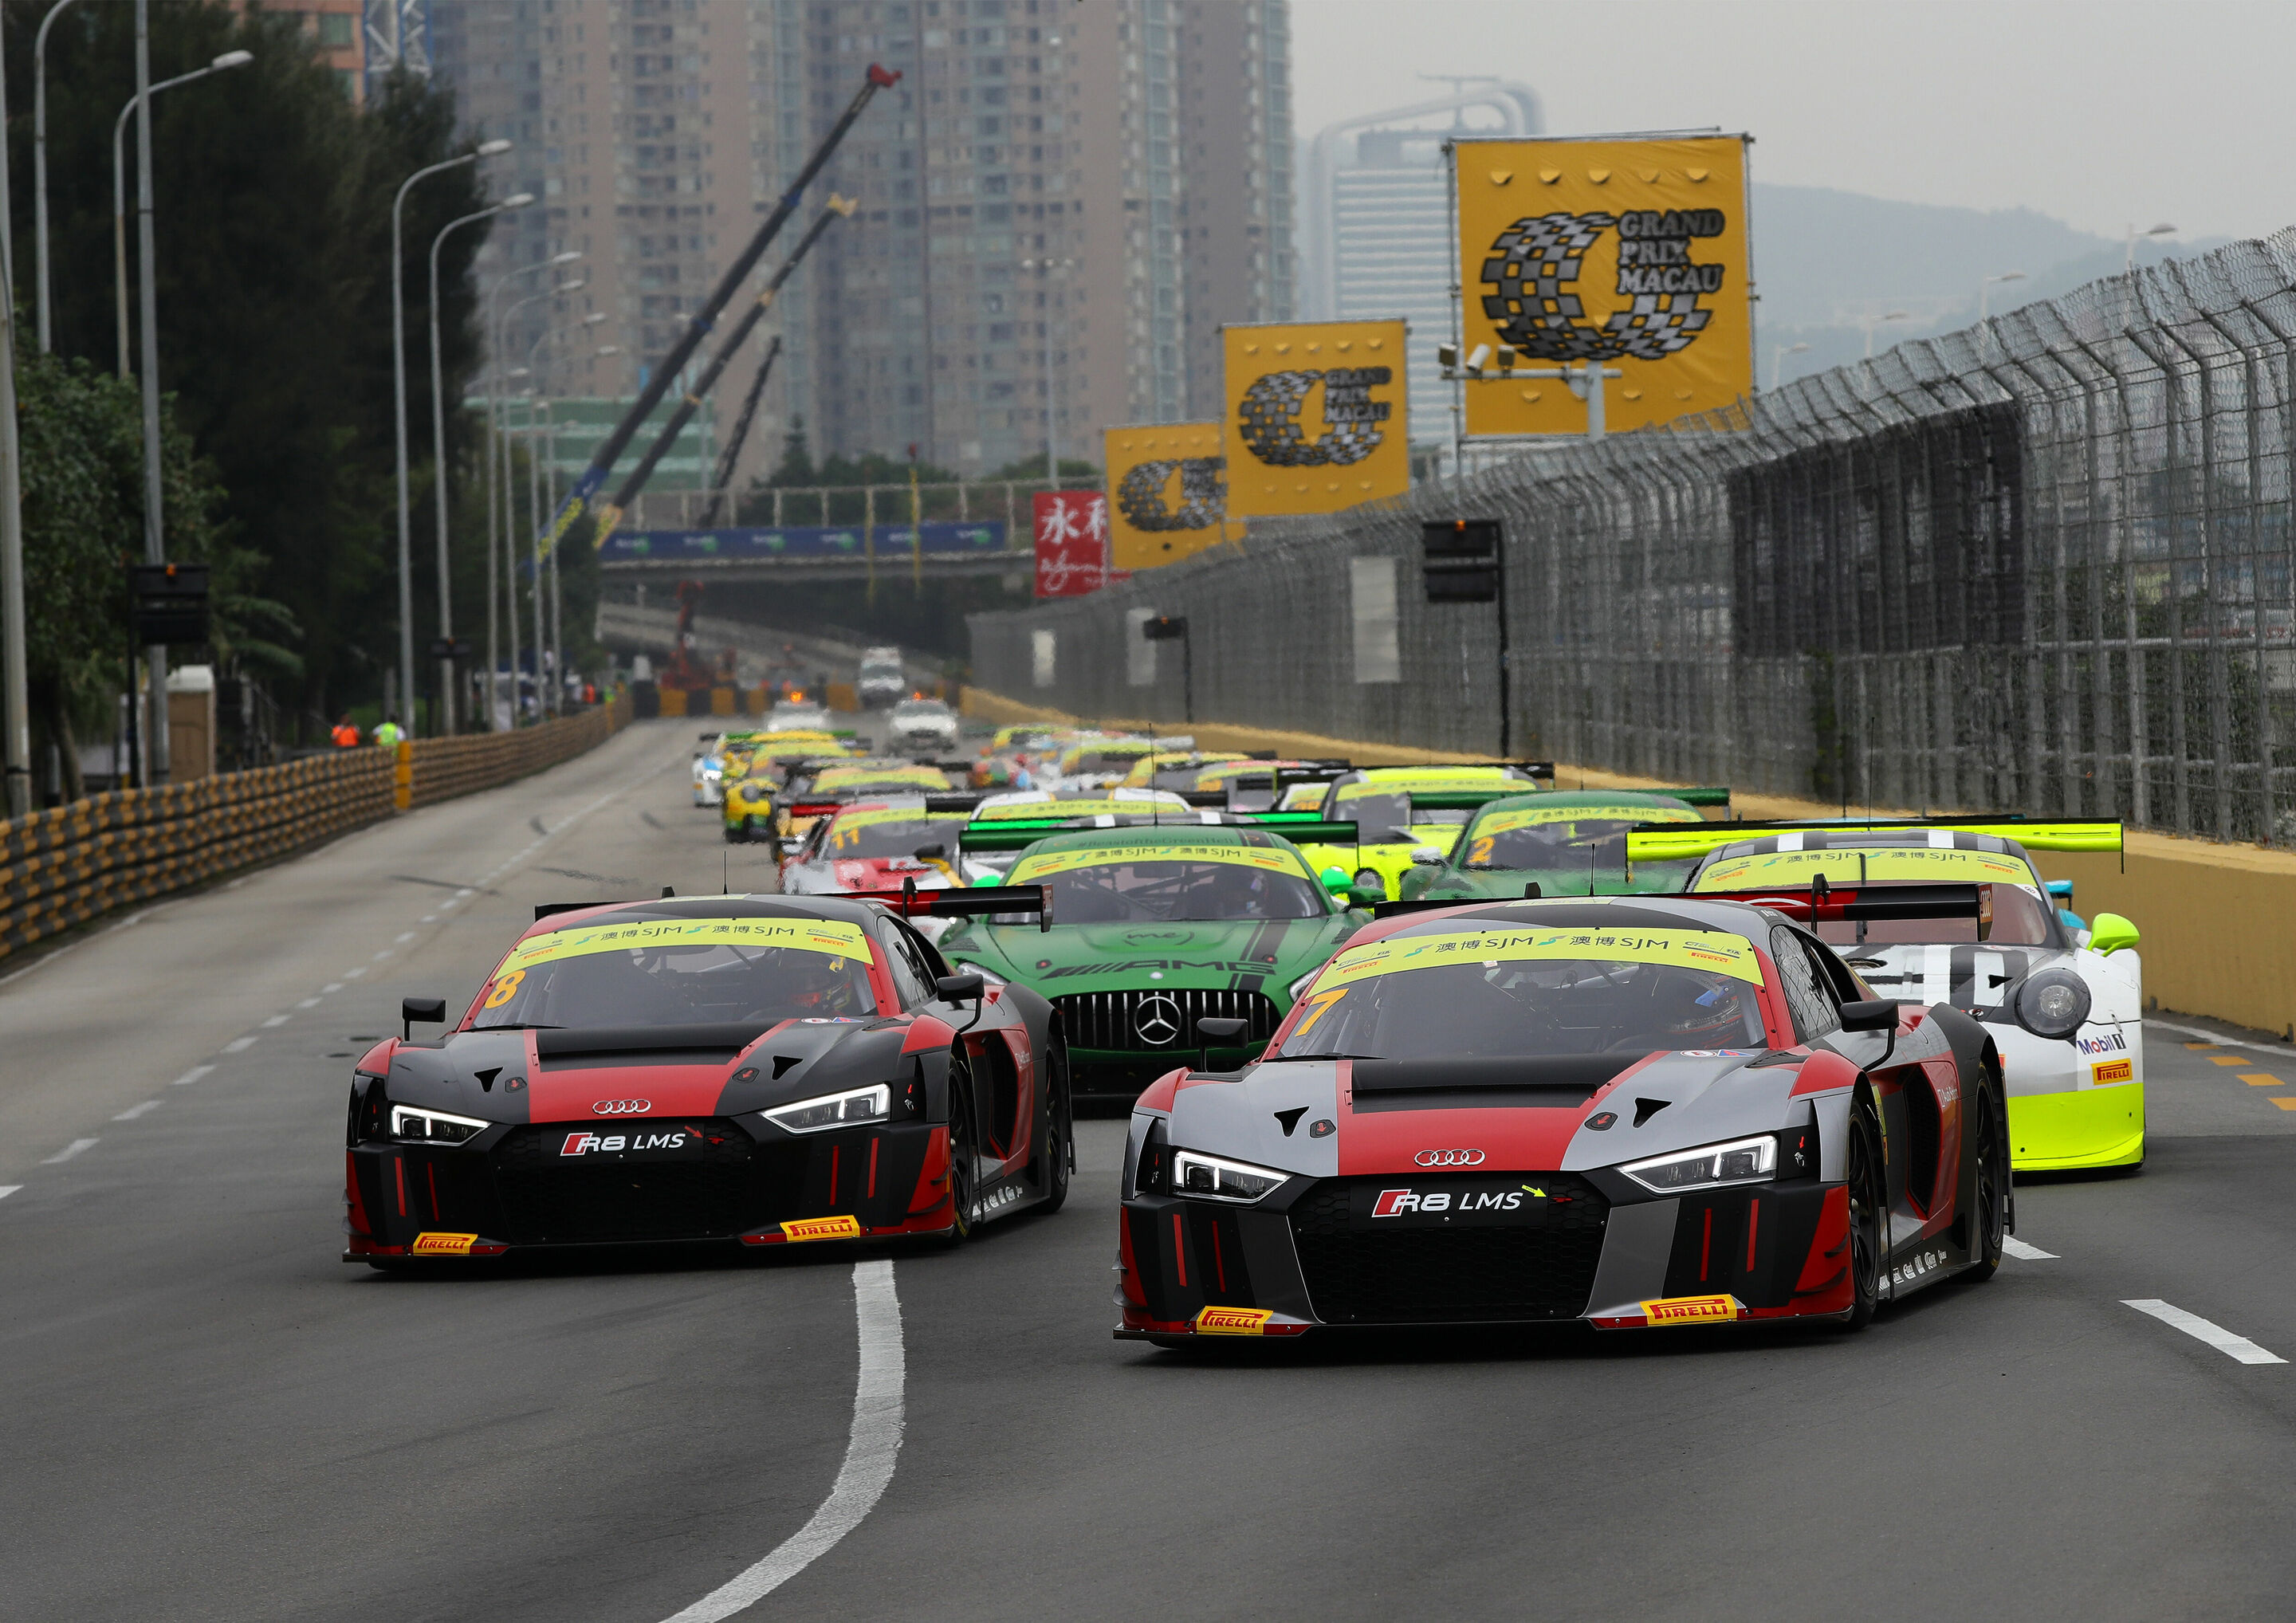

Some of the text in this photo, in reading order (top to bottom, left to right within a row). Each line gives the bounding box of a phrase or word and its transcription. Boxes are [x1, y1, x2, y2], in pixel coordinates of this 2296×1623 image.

[1618, 209, 1725, 238] GRAND
[1618, 238, 1691, 266] PRIX
[1617, 264, 1724, 295] MACAU
[1324, 366, 1392, 387] GRAND
[1324, 402, 1391, 422] MACAU
[831, 827, 859, 851] 11
[1468, 835, 1496, 863] 2
[1126, 847, 1157, 857] SJM
[1211, 848, 1240, 858] SJM
[1826, 851, 1863, 861] SJM
[1928, 852, 1967, 862] SJM
[600, 925, 795, 941] 澳博 SJM 澳博 SJM
[1435, 936, 1669, 953] 澳博 SJM 澳博 SJM
[1115, 959, 1277, 976] AMG
[484, 969, 527, 1009] 8
[1295, 988, 1350, 1037] 7
[2077, 1033, 2127, 1055] Mobil 1
[2097, 1063, 2130, 1081] PIRELLI
[575, 1133, 686, 1153] R8 LMS
[1390, 1192, 1523, 1213] R8 LMS
[788, 1219, 853, 1237] PIRELLI
[417, 1236, 470, 1249] PIRELLI
[1201, 1310, 1264, 1329] PIRELLI
[1649, 1299, 1728, 1320] PIRELLI
